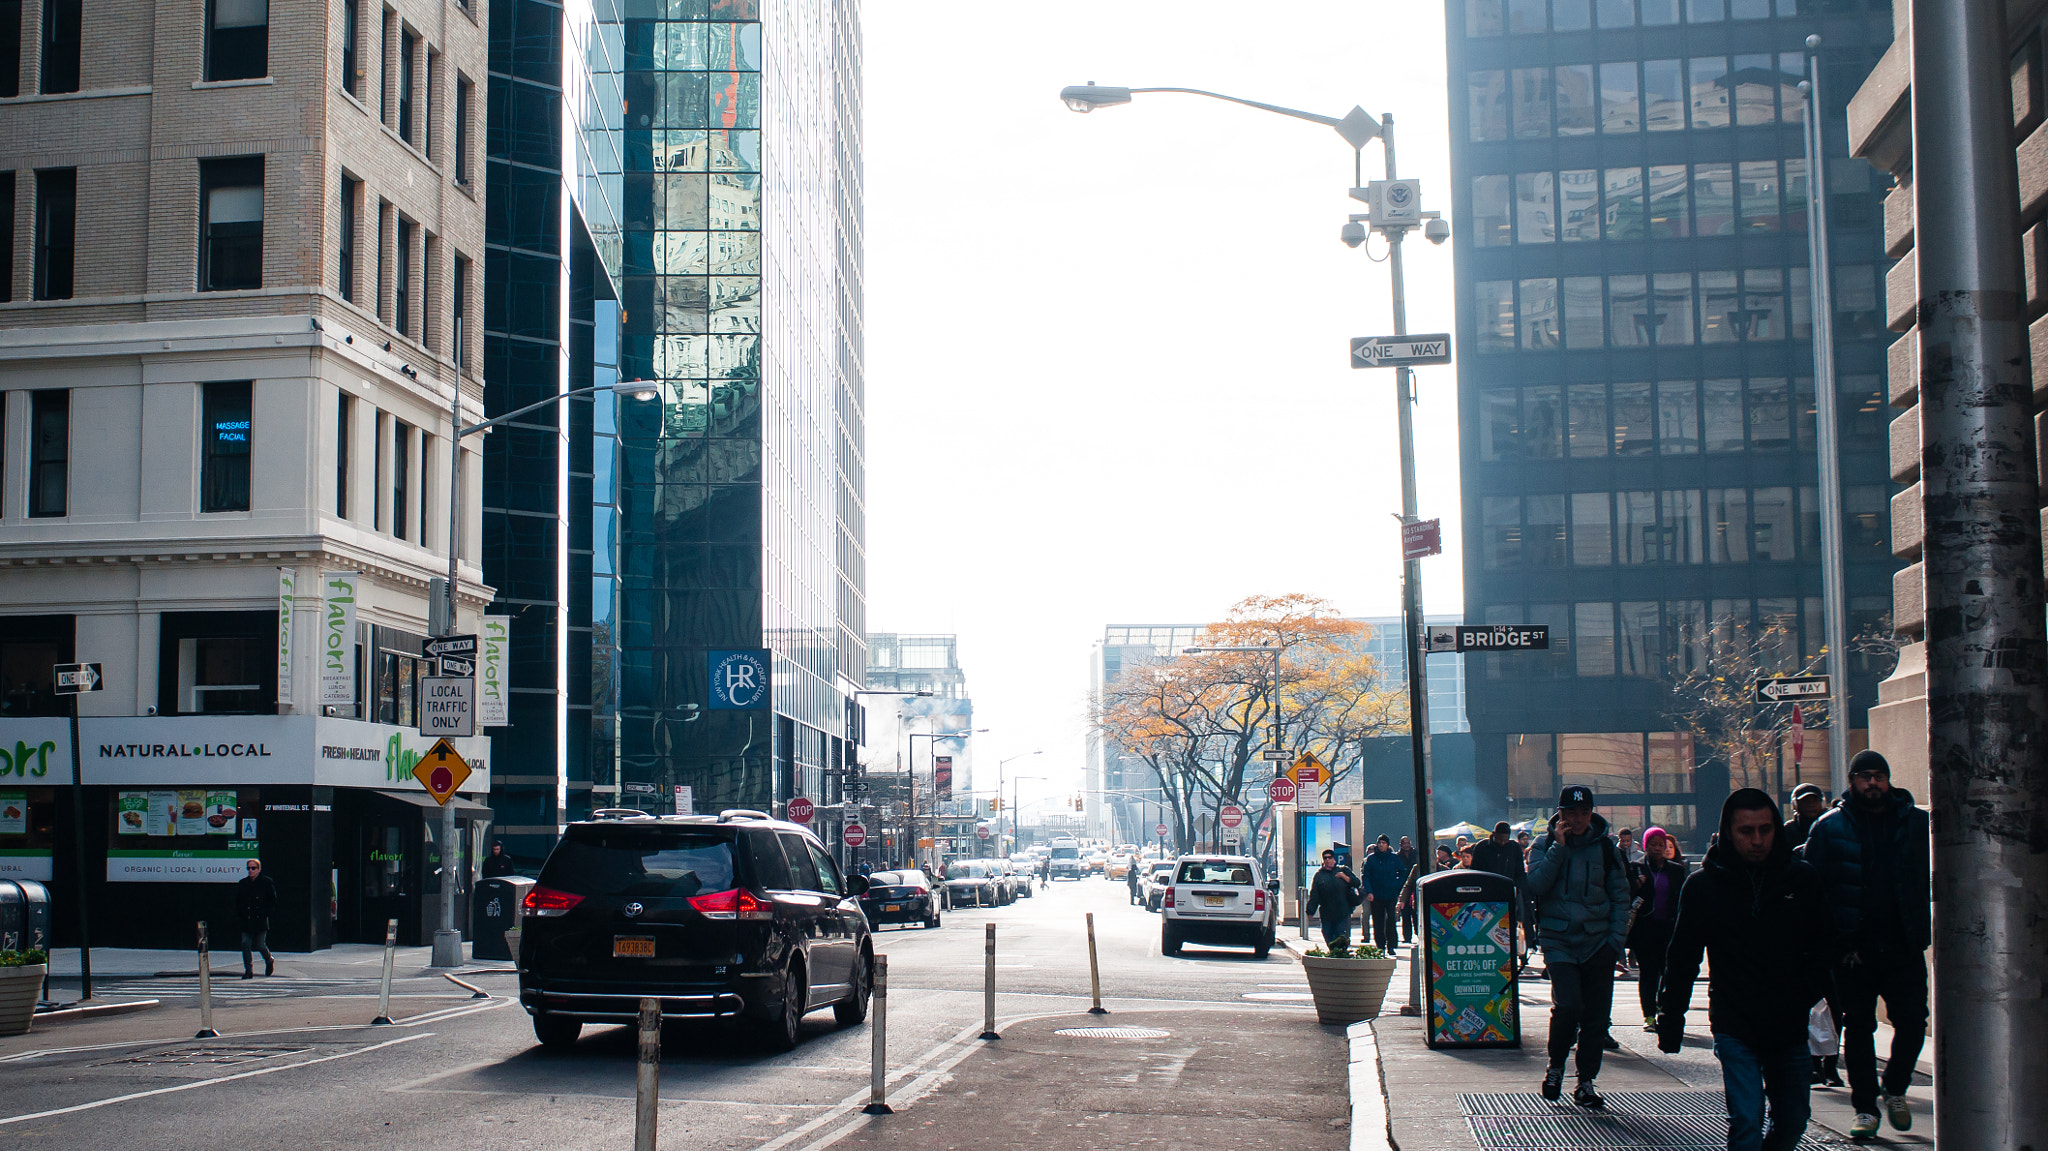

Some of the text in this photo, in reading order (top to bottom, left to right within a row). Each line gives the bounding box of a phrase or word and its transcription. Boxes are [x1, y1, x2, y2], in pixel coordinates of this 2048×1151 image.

[1361, 342, 1442, 359] ONE WAY
[216, 421, 250, 430] MASSAGE
[219, 432, 246, 441] FACIAL
[281, 576, 293, 672] flavors
[326, 577, 355, 673] flavors
[1463, 631, 1545, 647] BRIDGE ST
[432, 640, 470, 653] ONE WAY
[446, 660, 470, 673] ONE WAY
[485, 621, 508, 700] flavors
[718, 653, 743, 670] HEALTH
[748, 656, 767, 685] RACQUET
[61, 672, 76, 685] ONE
[713, 668, 723, 687] YORK
[431, 685, 464, 698] LOCAL
[715, 686, 728, 702] NEW
[751, 685, 765, 702] CLUB
[1767, 683, 1821, 695] ONE WAY
[427, 700, 468, 713] TRAFFIC
[432, 716, 461, 729] ONLY
[99, 743, 272, 758] NATURAL LOCAL
[1271, 786, 1294, 797] STOP
[789, 804, 813, 817] STOP
[244, 822, 254, 834] A
[370, 849, 403, 862] flavors
[1337, 855, 1345, 864] P
[205, 866, 241, 874] QUALITY
[1447, 945, 1496, 955] BOXED
[1446, 959, 1497, 971] GET 20% OFF
[1454, 984, 1491, 993] DOWNTOWN
[1462, 1009, 1487, 1031] Welch's
